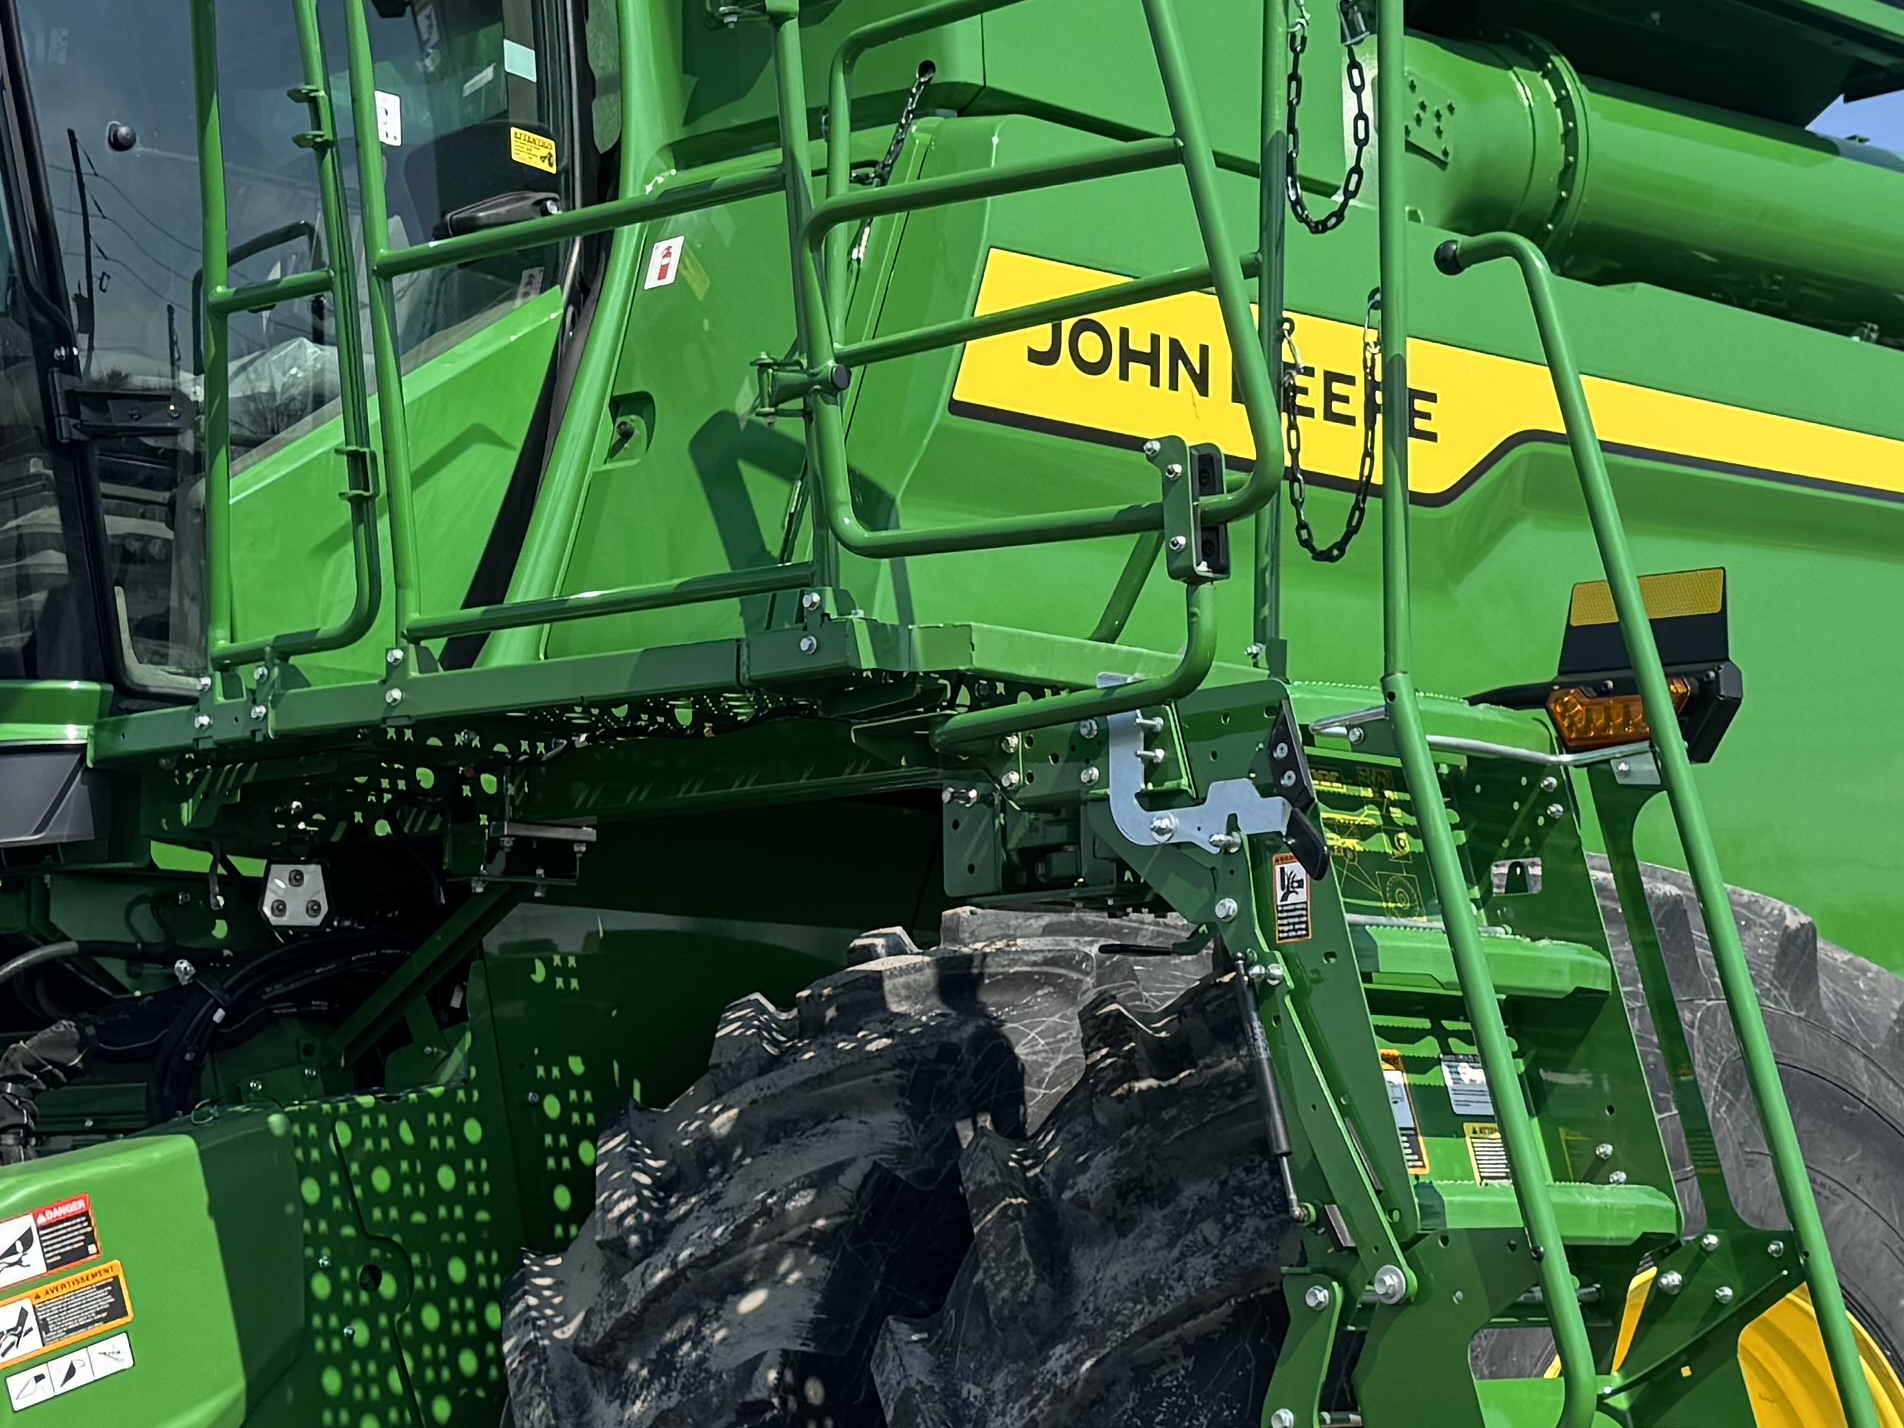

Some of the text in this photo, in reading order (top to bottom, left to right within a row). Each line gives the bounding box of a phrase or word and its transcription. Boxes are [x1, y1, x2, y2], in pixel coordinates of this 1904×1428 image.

[1026, 318, 1438, 444] JOHN EEE
[45, 1199, 86, 1221] DANGER
[45, 1265, 115, 1297] AVERTISSEMENT
